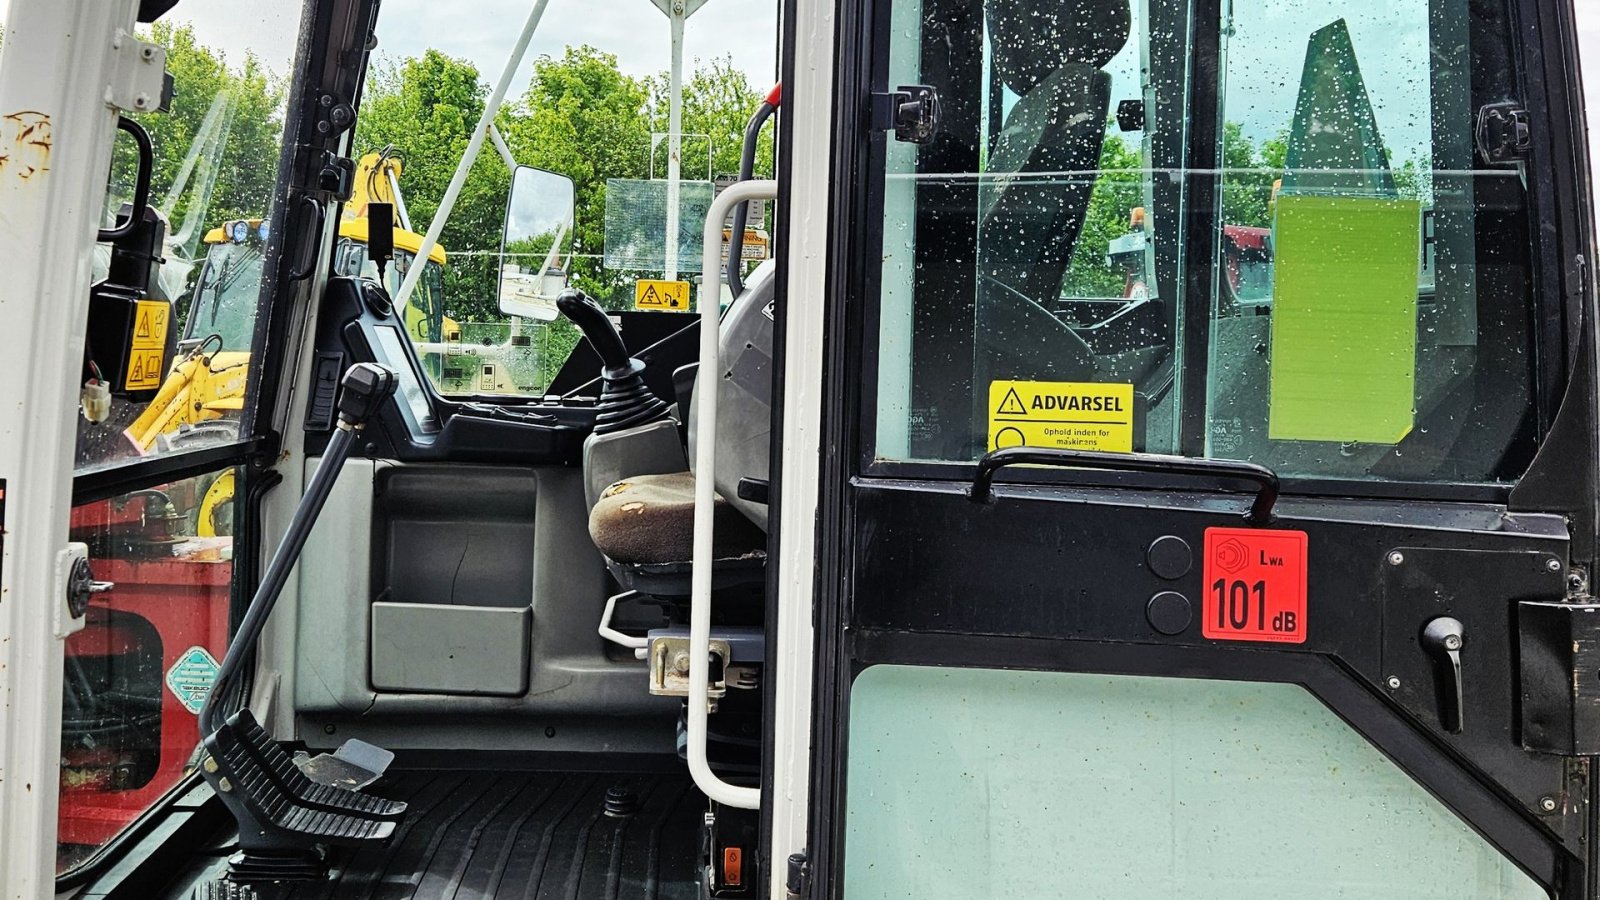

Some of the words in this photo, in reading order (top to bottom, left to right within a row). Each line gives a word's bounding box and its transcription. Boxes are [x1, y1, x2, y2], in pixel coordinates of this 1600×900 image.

[1031, 395, 1123, 412] ADVARSEL
[1044, 428, 1071, 436] Ophold
[1213, 578, 1266, 631] 101
[1272, 611, 1297, 632] dB
